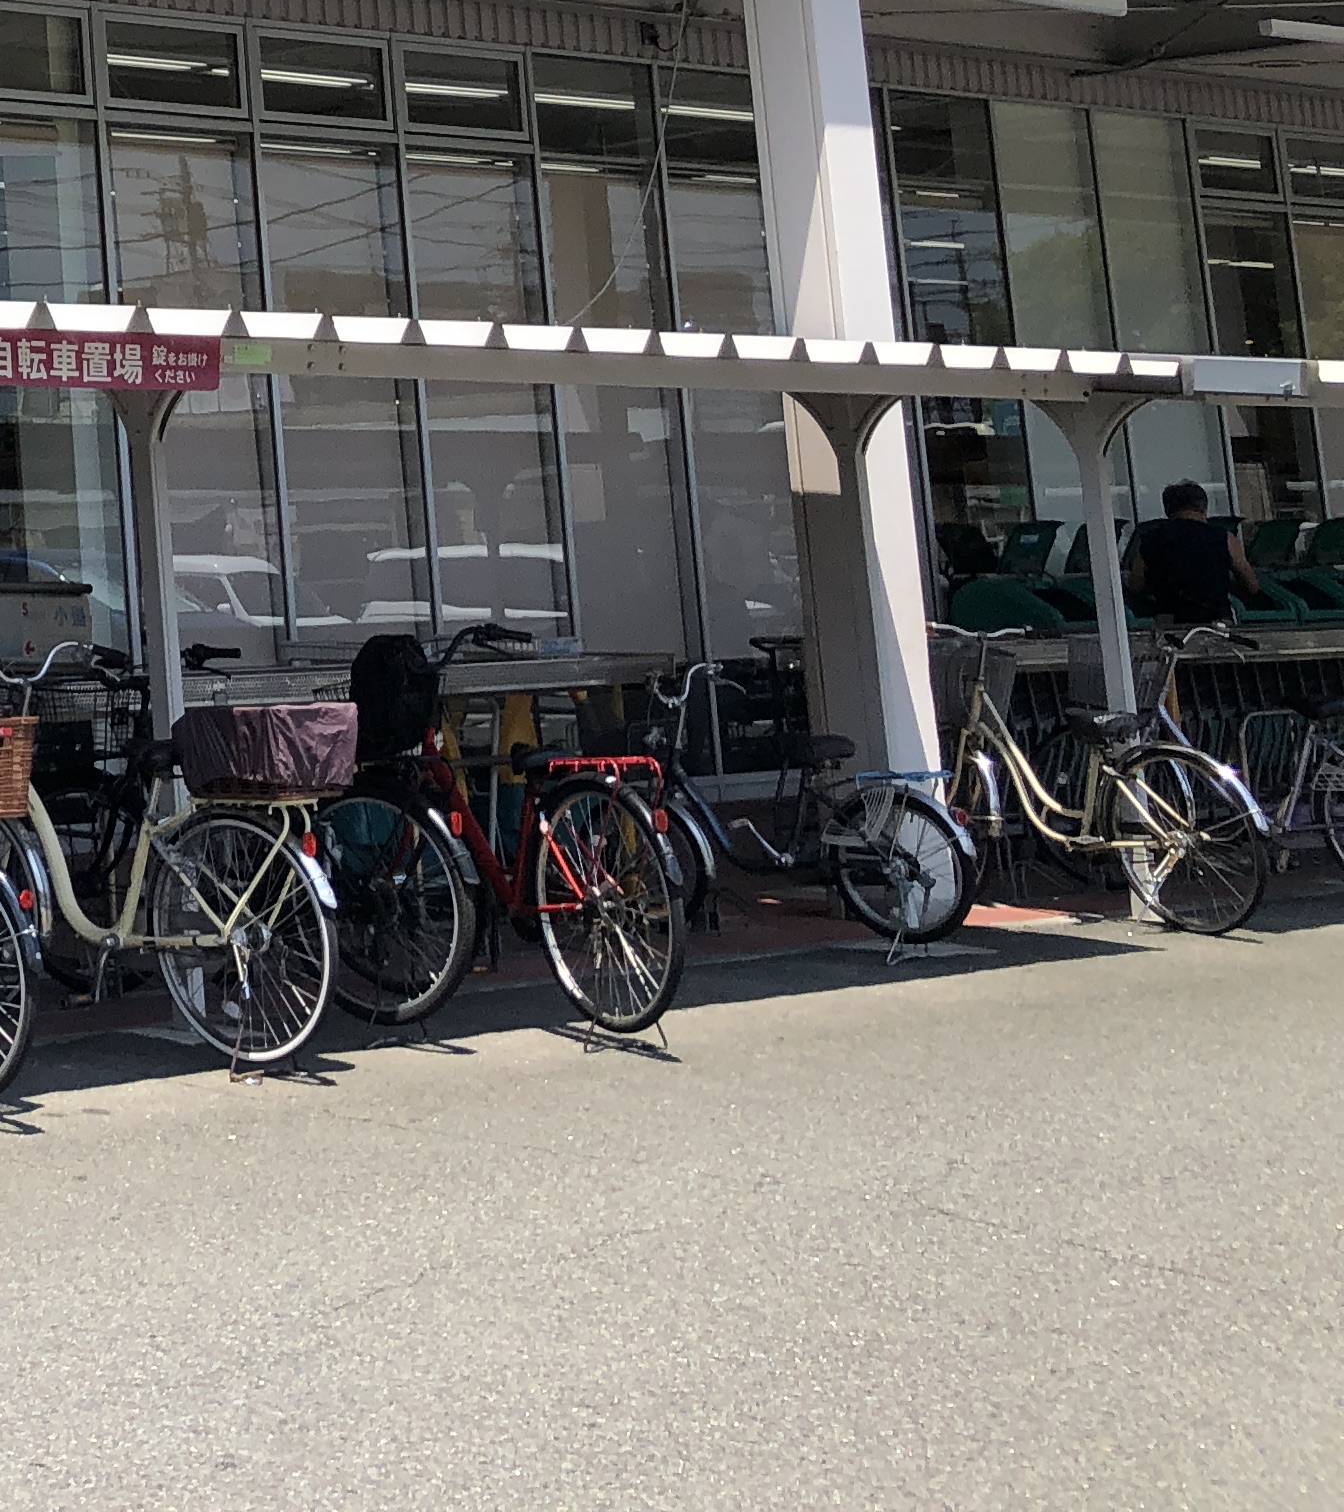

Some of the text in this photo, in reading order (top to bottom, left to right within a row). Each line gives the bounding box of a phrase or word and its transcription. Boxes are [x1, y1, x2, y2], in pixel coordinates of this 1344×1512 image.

[151, 344, 209, 368] 錠をお掛け
[153, 368, 196, 384] ください
